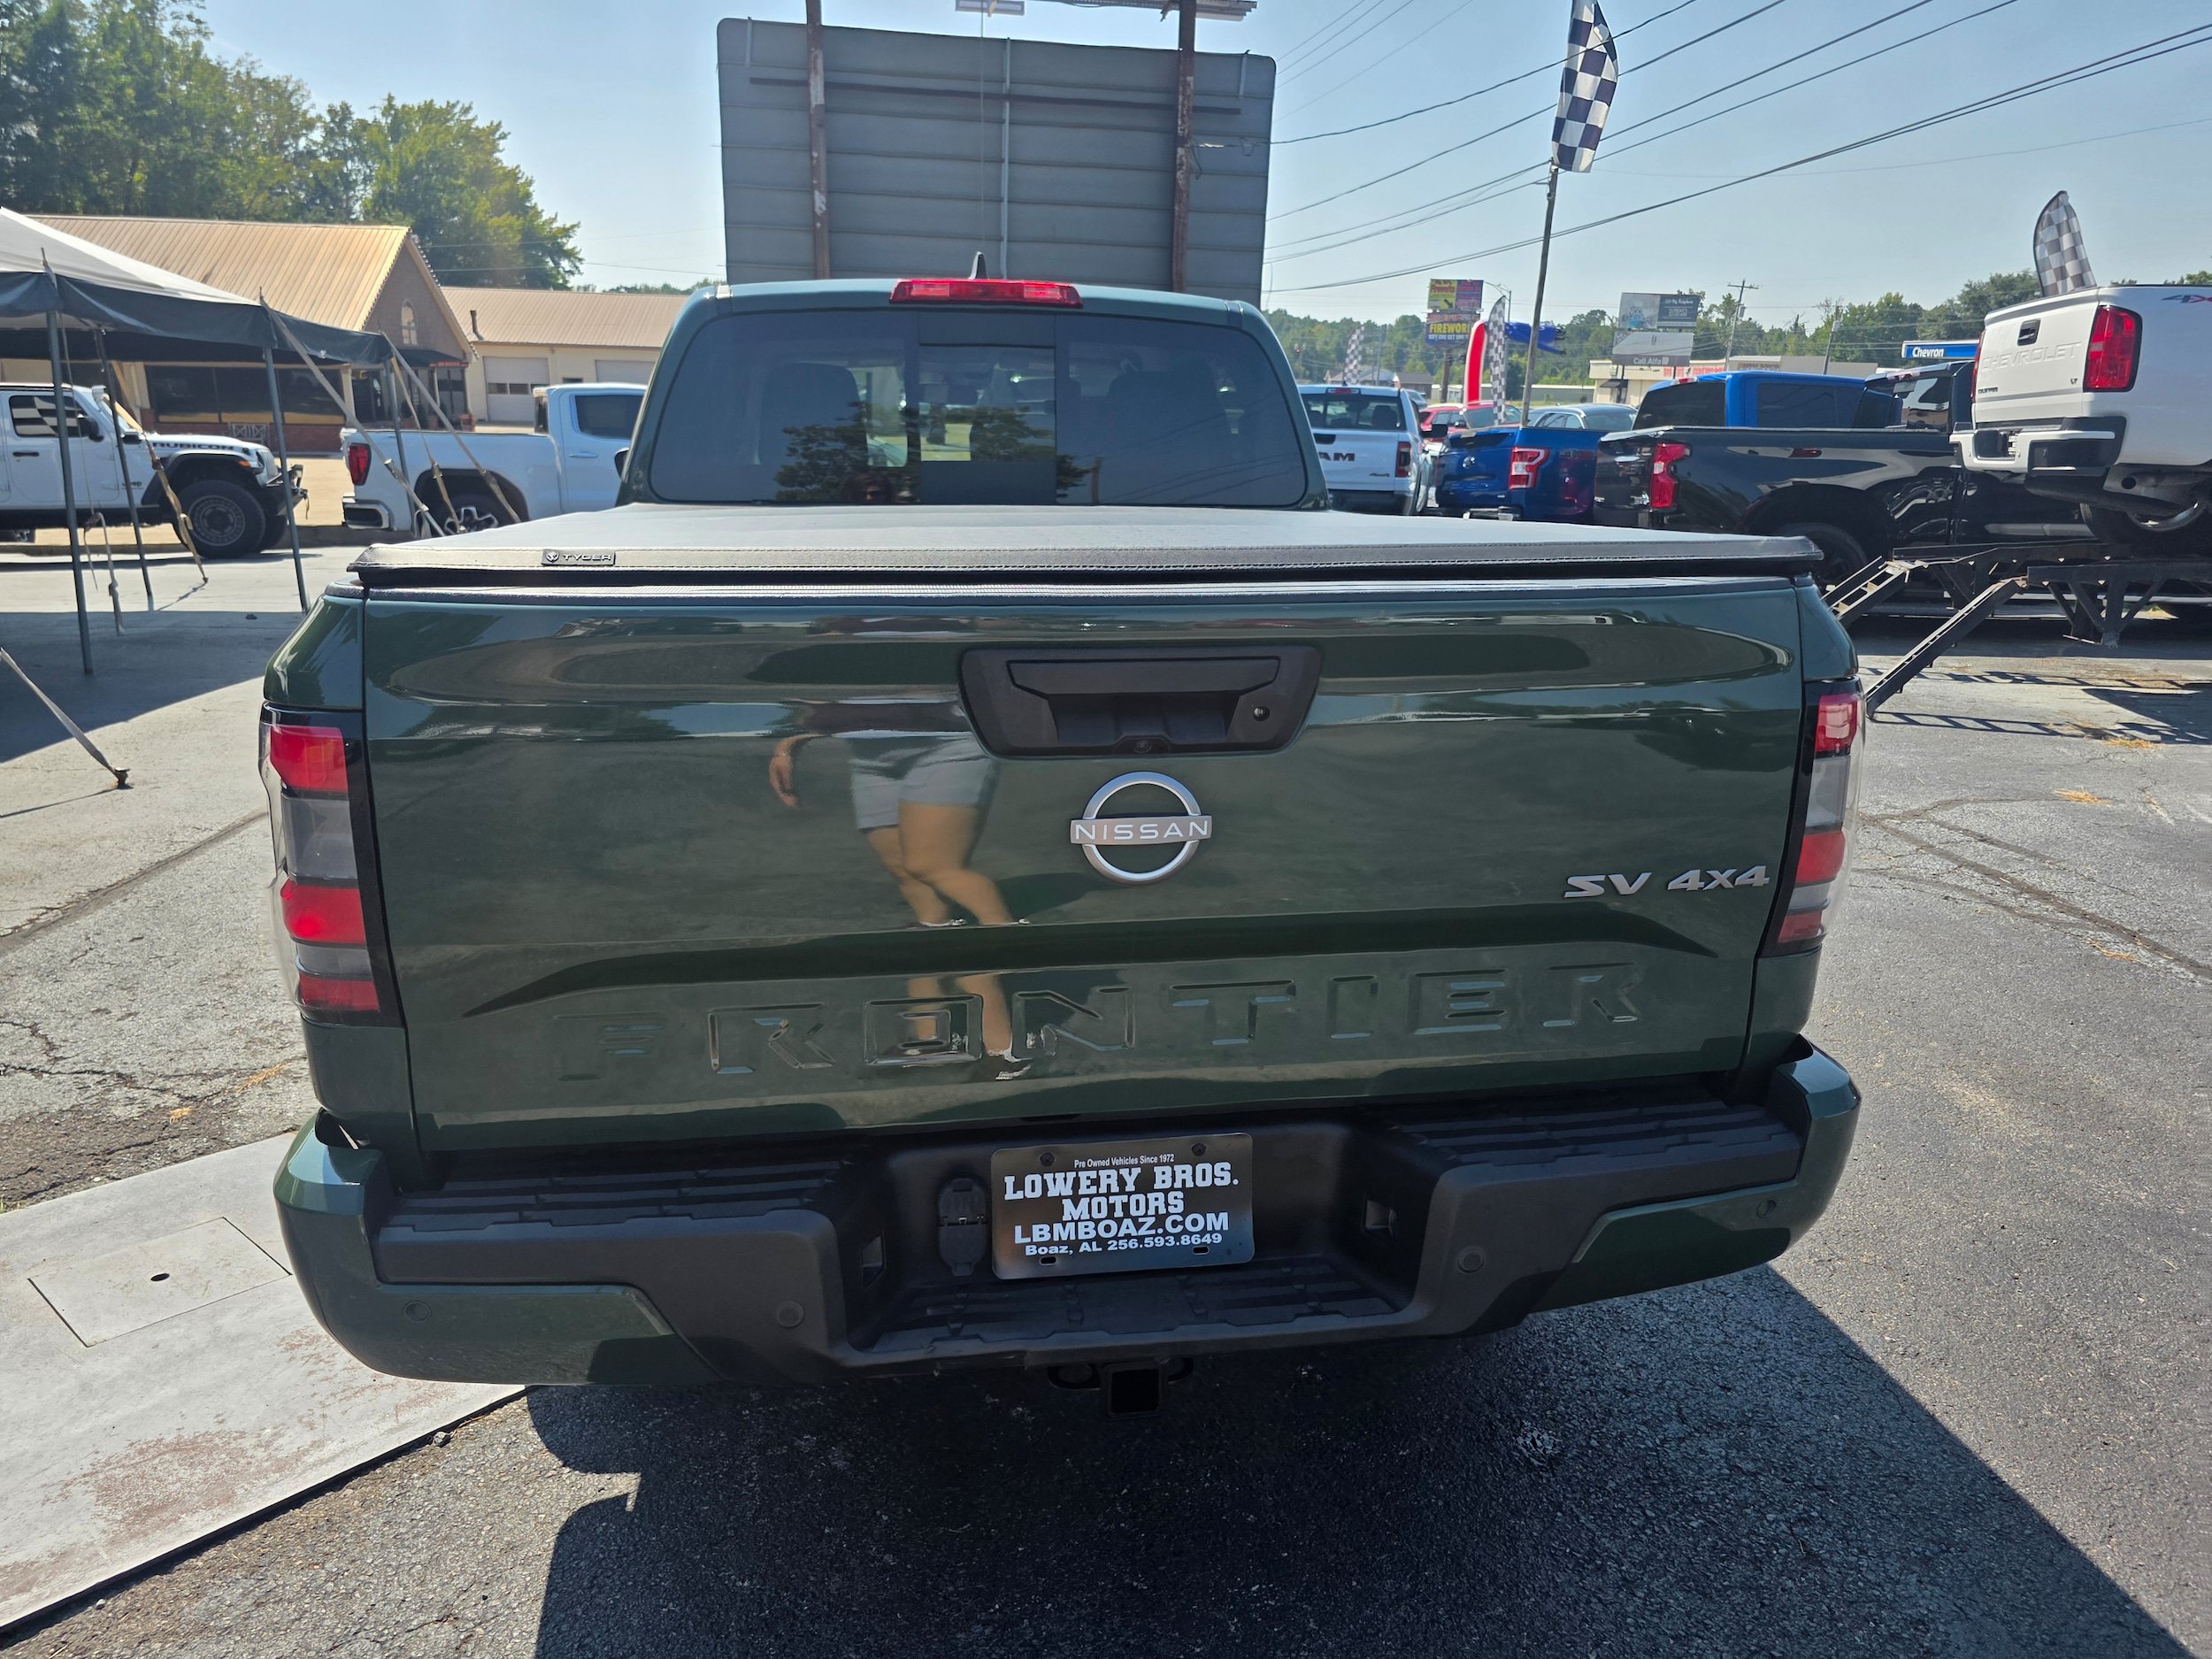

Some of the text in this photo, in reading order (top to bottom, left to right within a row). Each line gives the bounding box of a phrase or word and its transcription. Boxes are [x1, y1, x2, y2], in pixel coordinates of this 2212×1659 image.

[1912, 347, 1945, 358] Chevron
[1980, 342, 2082, 372] CHEVROLET
[152, 442, 234, 450] RUBICON
[1318, 451, 1356, 462] AM
[1075, 819, 1209, 841] NISSAN
[1563, 872, 1653, 899] SV
[550, 962, 1644, 1083] FRONTIER
[1073, 1153, 1175, 1168] Pre Owned Vehicles Since 1972
[1003, 1161, 1240, 1201] LOWERY BROS.
[1062, 1190, 1185, 1222] MOTORS
[1014, 1211, 1230, 1245] LBMBOAZ.COM
[1025, 1233, 1223, 1256] Boaz, AL 256.593.8649
